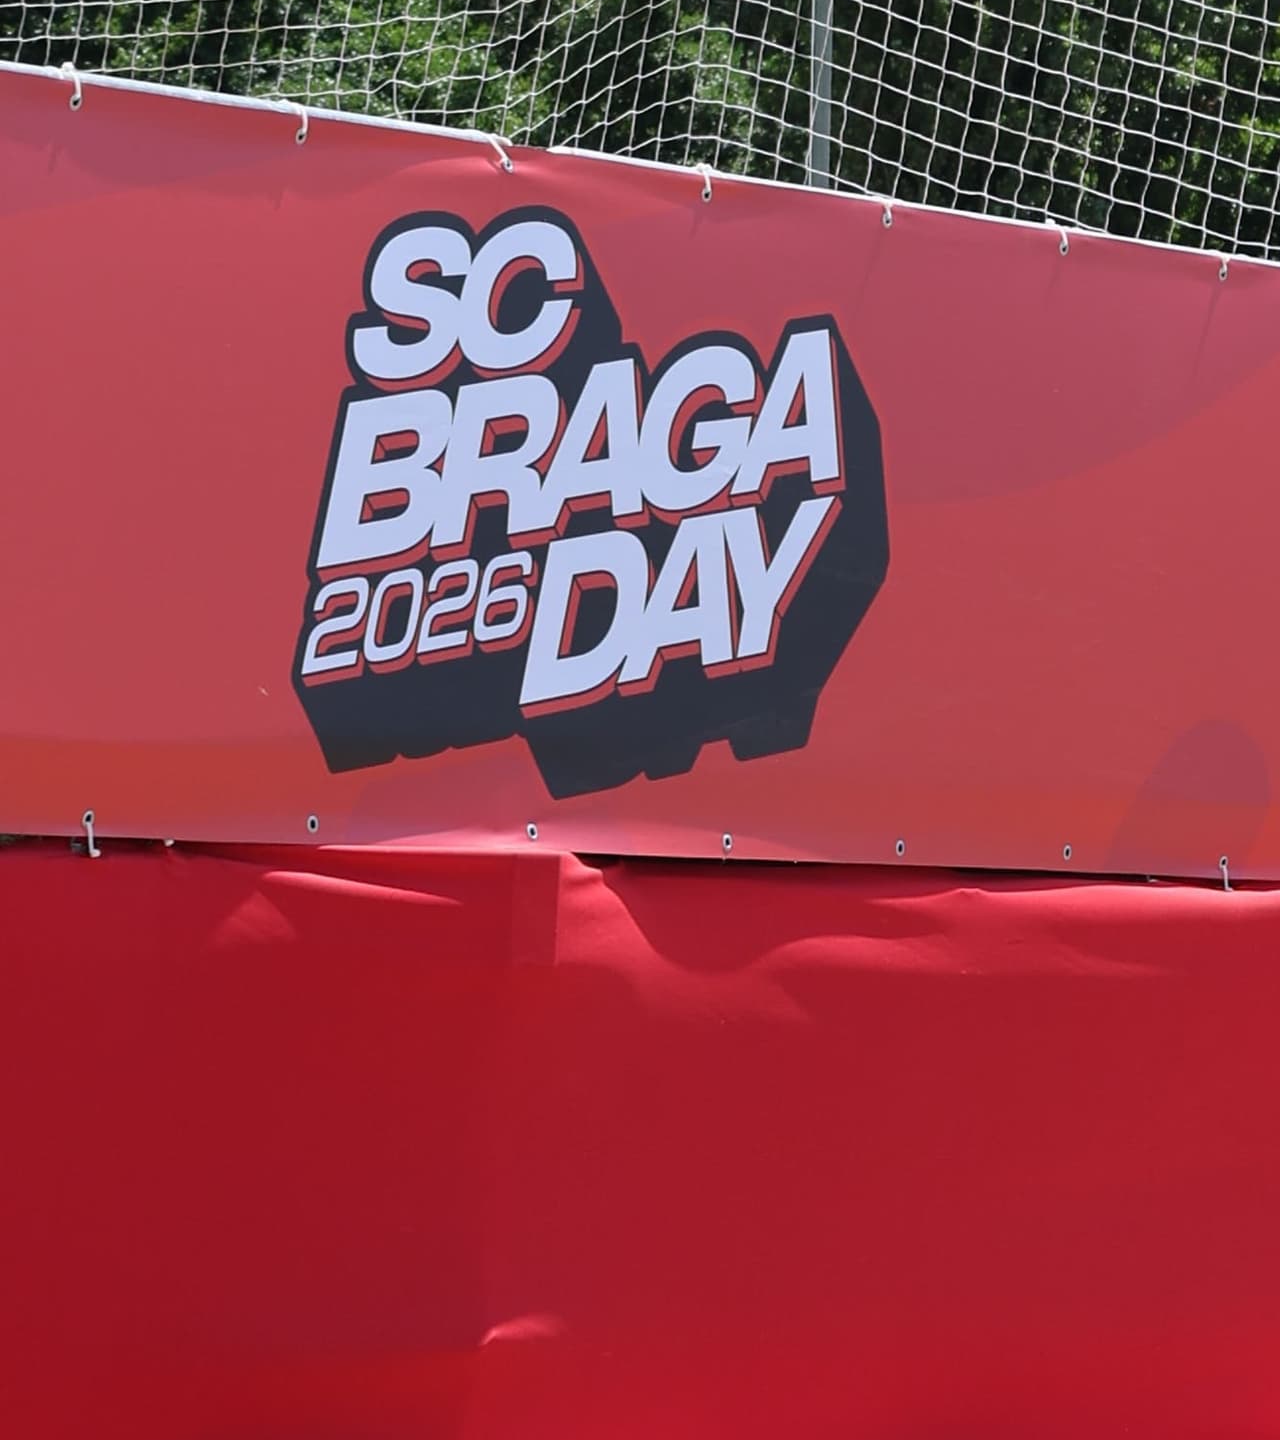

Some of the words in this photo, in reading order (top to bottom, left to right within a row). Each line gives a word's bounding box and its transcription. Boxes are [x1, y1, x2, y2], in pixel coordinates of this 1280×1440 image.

[353, 221, 577, 380] SC
[316, 328, 840, 568] BRAGA
[301, 550, 533, 676] 2026
[518, 496, 837, 705] DAY
